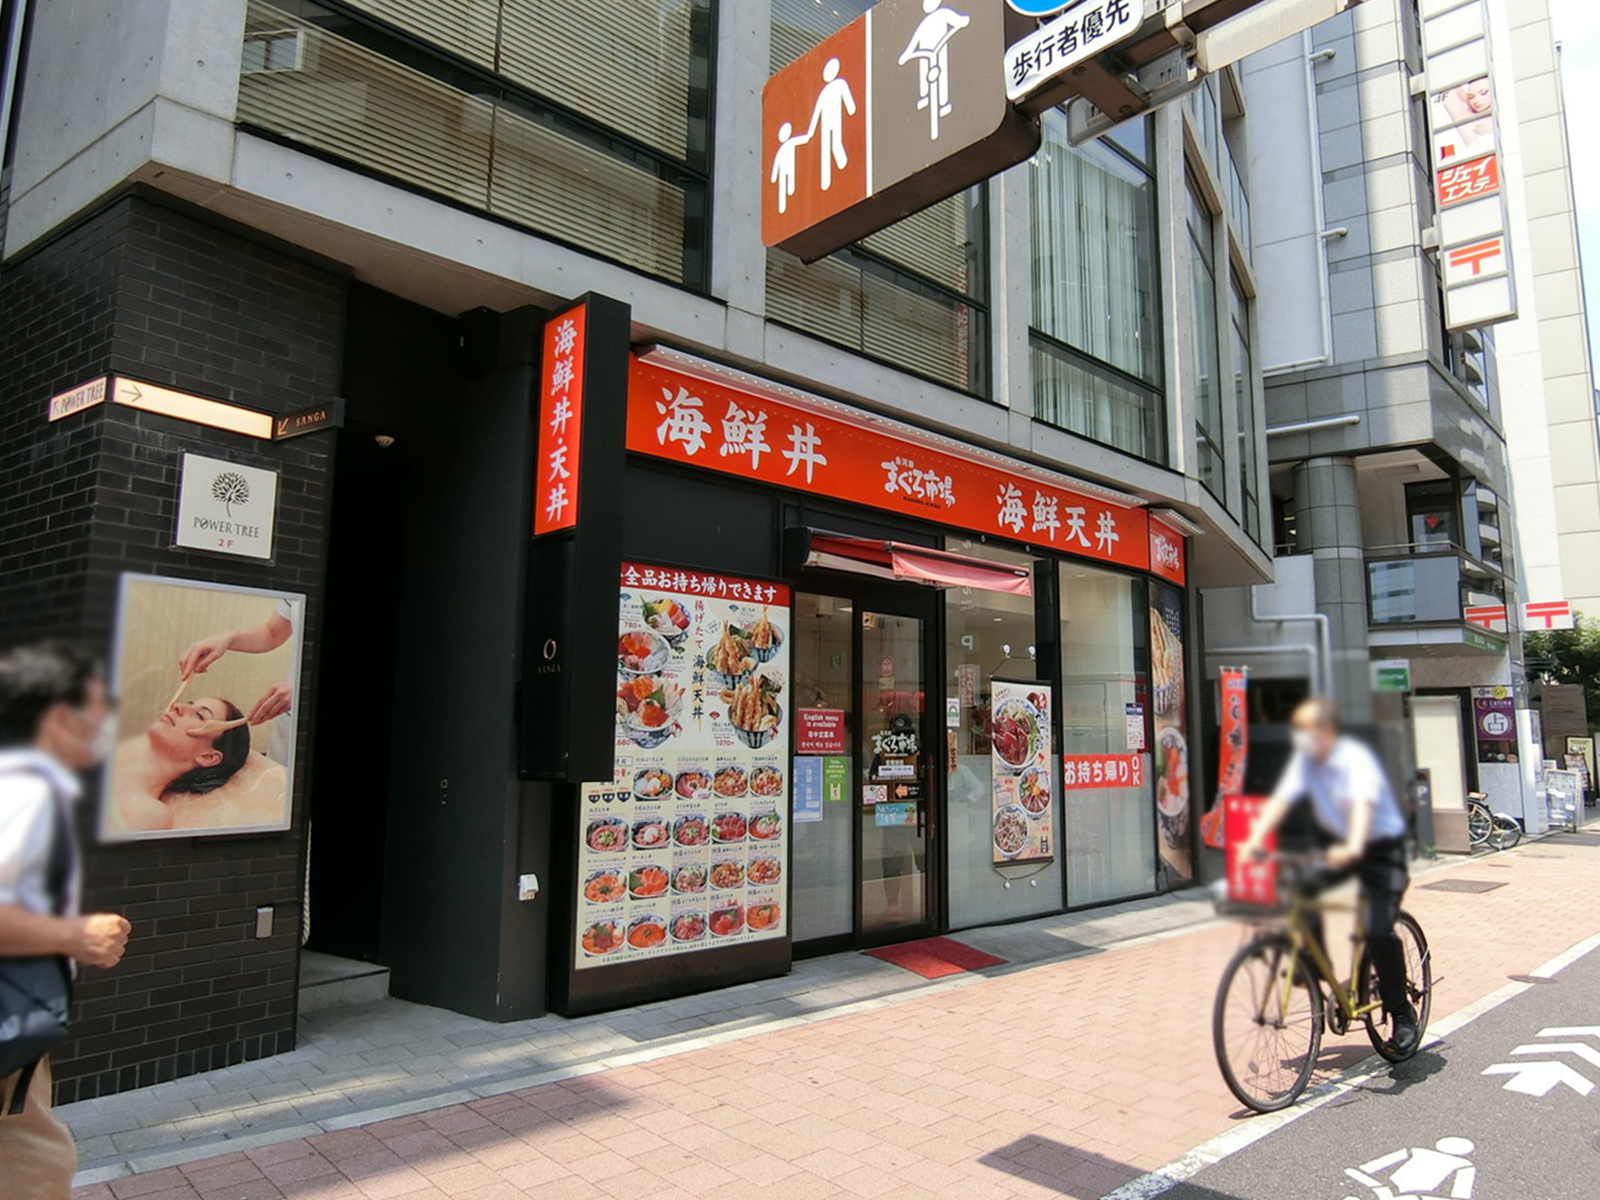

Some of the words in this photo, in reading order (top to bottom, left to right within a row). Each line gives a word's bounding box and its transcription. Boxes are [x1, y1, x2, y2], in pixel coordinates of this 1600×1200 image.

[1013, 0, 1130, 86] 歩行者優先
[295, 410, 327, 427] SANGA
[655, 385, 828, 485] 海鮮丼
[881, 460, 956, 509] まぐろ市場
[235, 524, 260, 539] TREE
[996, 482, 1119, 556] 海鮮天丼
[624, 565, 777, 603] 全品お持ち帰りできます
[804, 714, 823, 722] English
[871, 732, 918, 754] まぐろ市場
[1064, 760, 1129, 785] お持ち帰り
